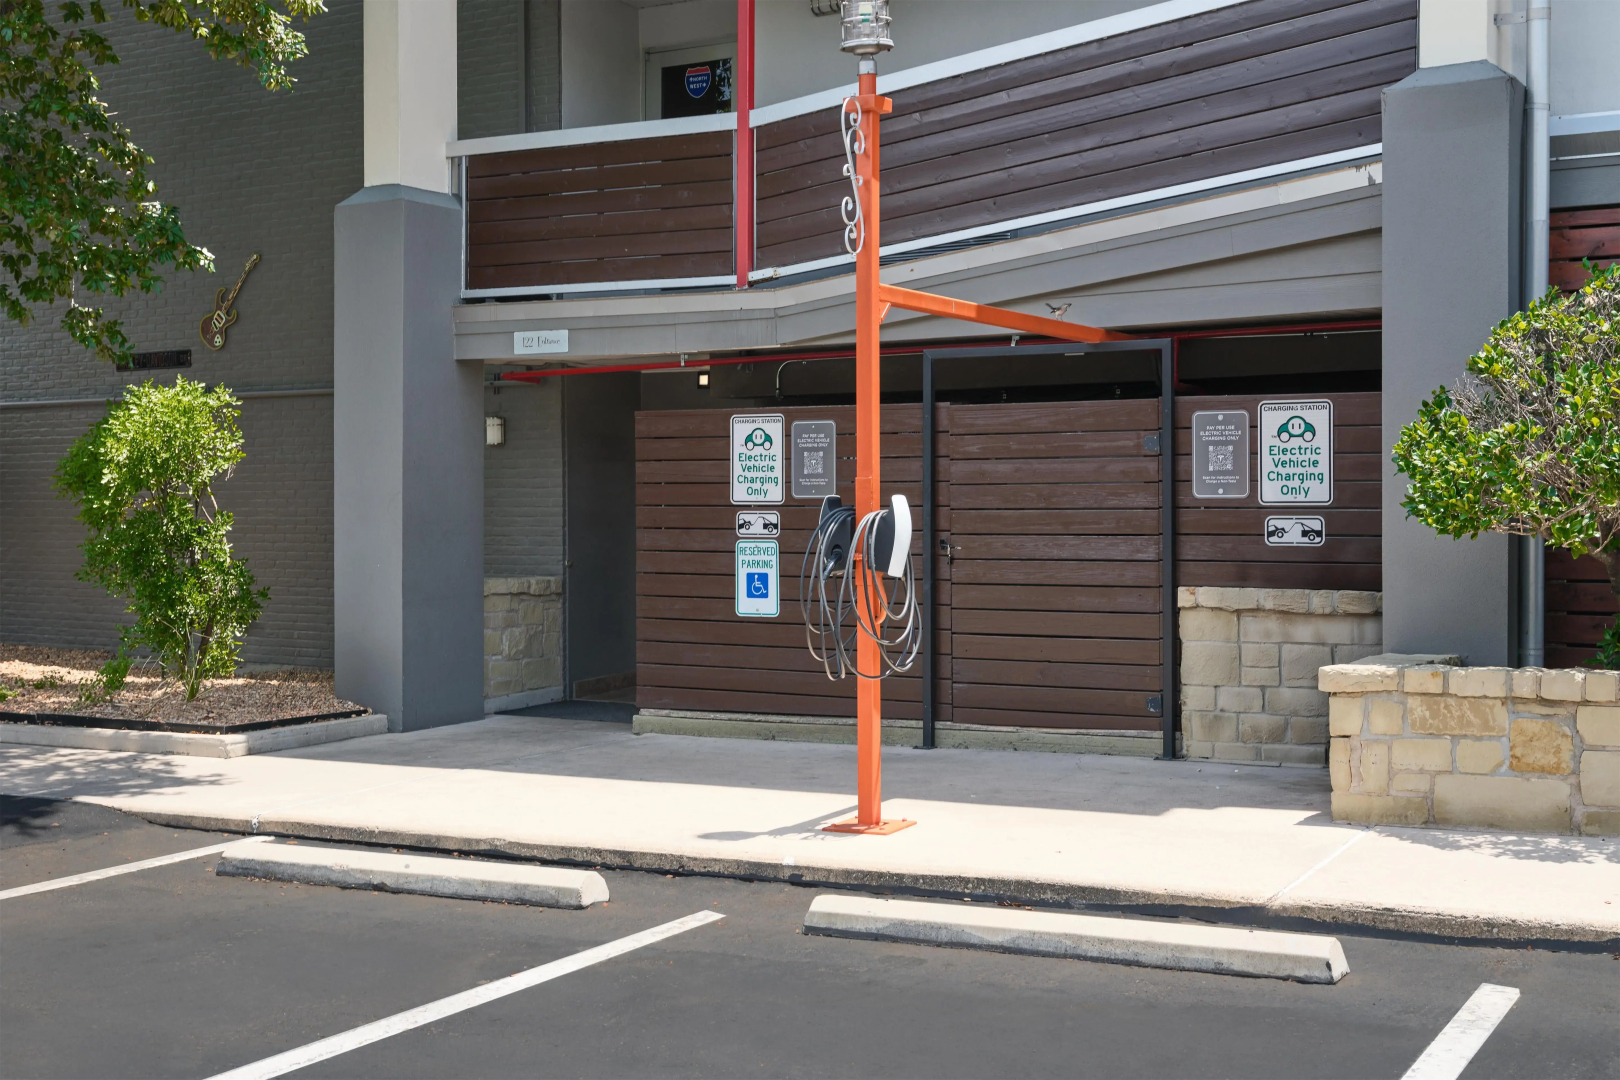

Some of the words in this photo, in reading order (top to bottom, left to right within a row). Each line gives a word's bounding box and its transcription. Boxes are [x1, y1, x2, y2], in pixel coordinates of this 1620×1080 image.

[522, 336, 534, 348] 122
[1269, 445, 1321, 456] Electric
[738, 453, 776, 462] Electric
[1272, 458, 1319, 468] Vehicle
[741, 464, 775, 472] Vehicle
[737, 475, 778, 486] Charging
[1267, 471, 1324, 484] Charging
[747, 487, 768, 498] Only
[1281, 485, 1310, 498] Only
[740, 546, 775, 556] RESERVED
[742, 560, 773, 569] PARKING
